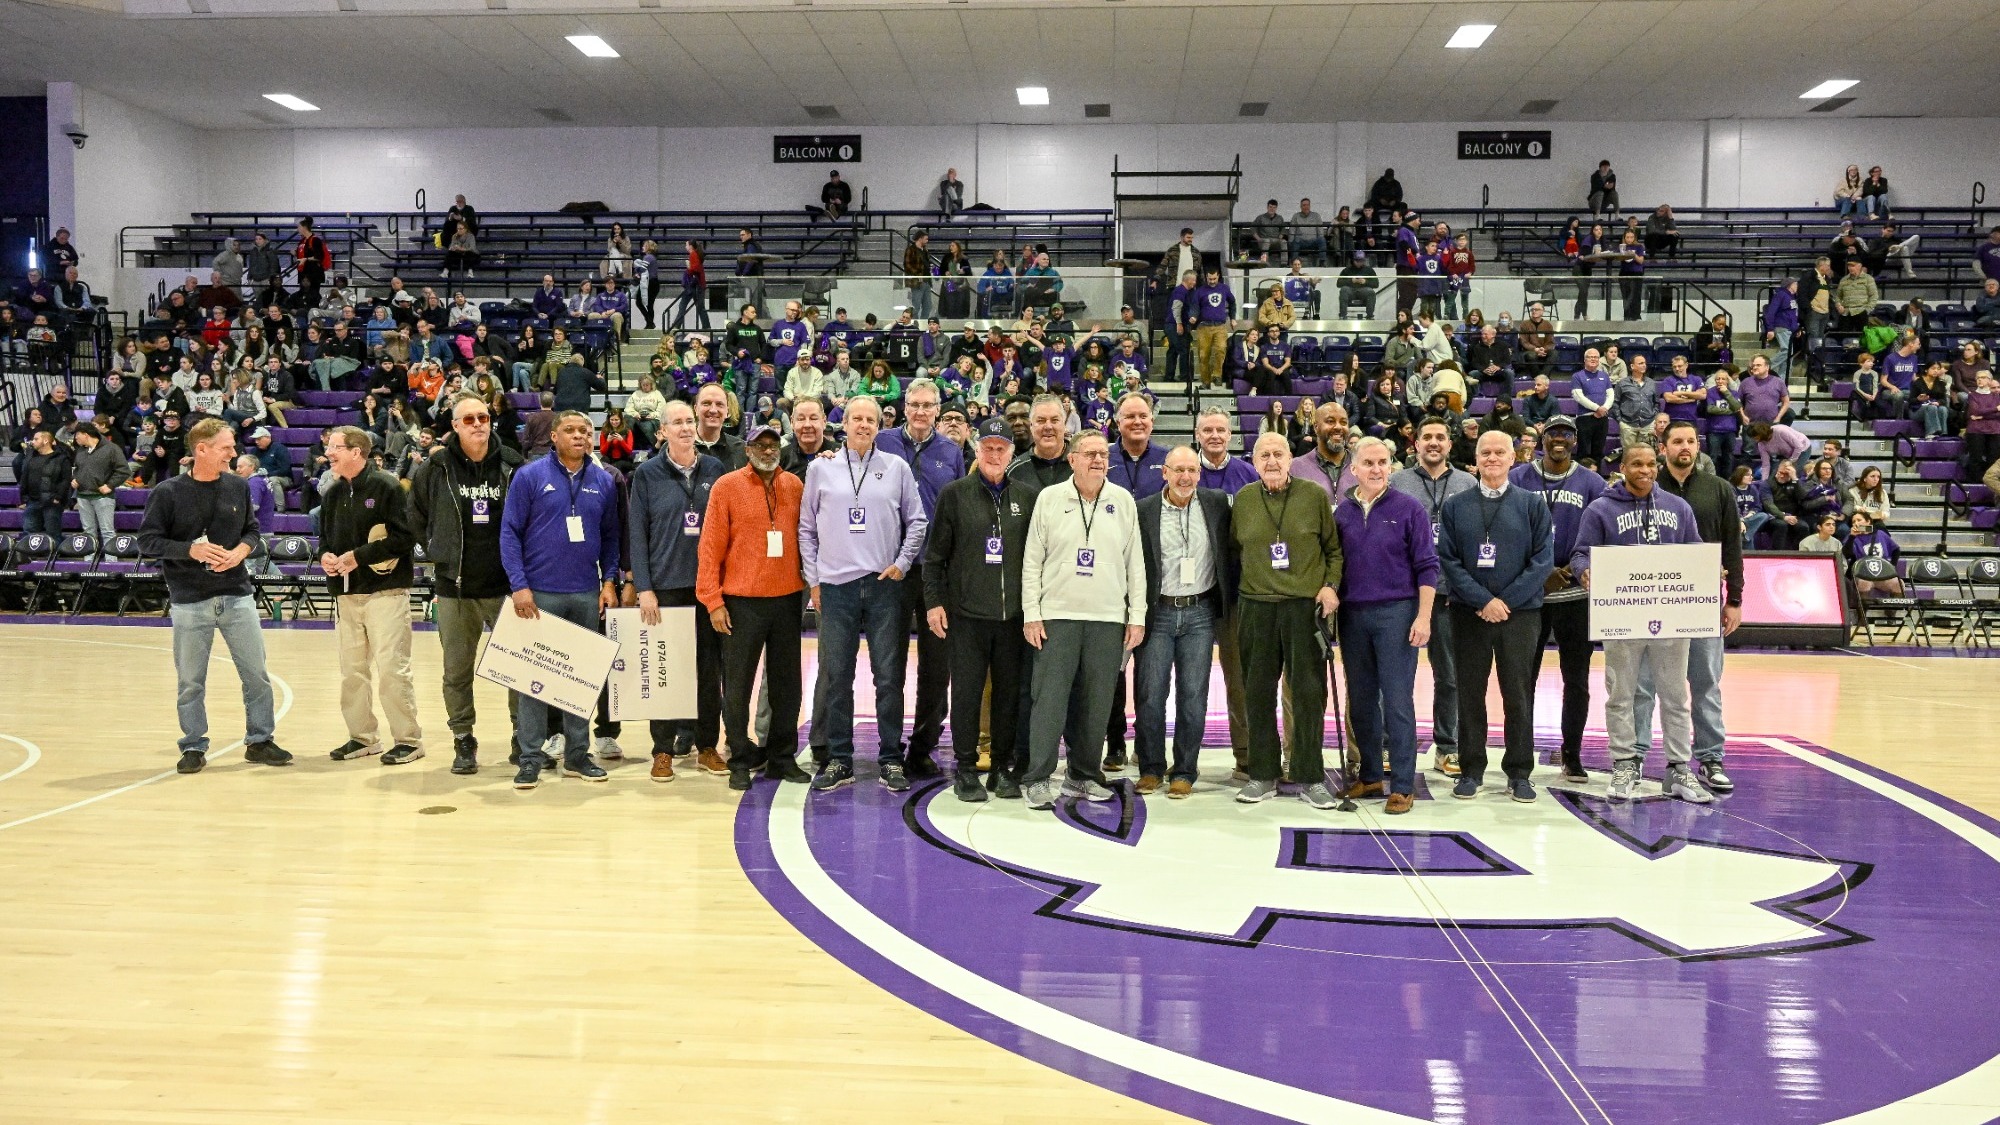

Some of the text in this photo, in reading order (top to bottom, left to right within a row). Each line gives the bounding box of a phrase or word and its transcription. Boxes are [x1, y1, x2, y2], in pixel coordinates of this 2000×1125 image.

[780, 147, 834, 159] BALCONY
[1465, 143, 1522, 155] BALCONY
[900, 344, 910, 358] B
[1551, 489, 1584, 509] CROSS
[1617, 509, 1678, 535] HOLY CROSS
[1628, 572, 1682, 581] 2004-2005
[1616, 584, 1695, 593] PATRIOT LEAGUE
[1593, 596, 1718, 606] TOURNAMENT CHAMPIONS
[522, 647, 574, 673] NIT QUALIFIER
[533, 641, 570, 661] 1989-1990
[490, 642, 600, 691] MAAC NORTH DIVISION CHAMPIONS
[640, 629, 650, 699] NIT QUALIFIER
[657, 640, 667, 688] 1974-1975
